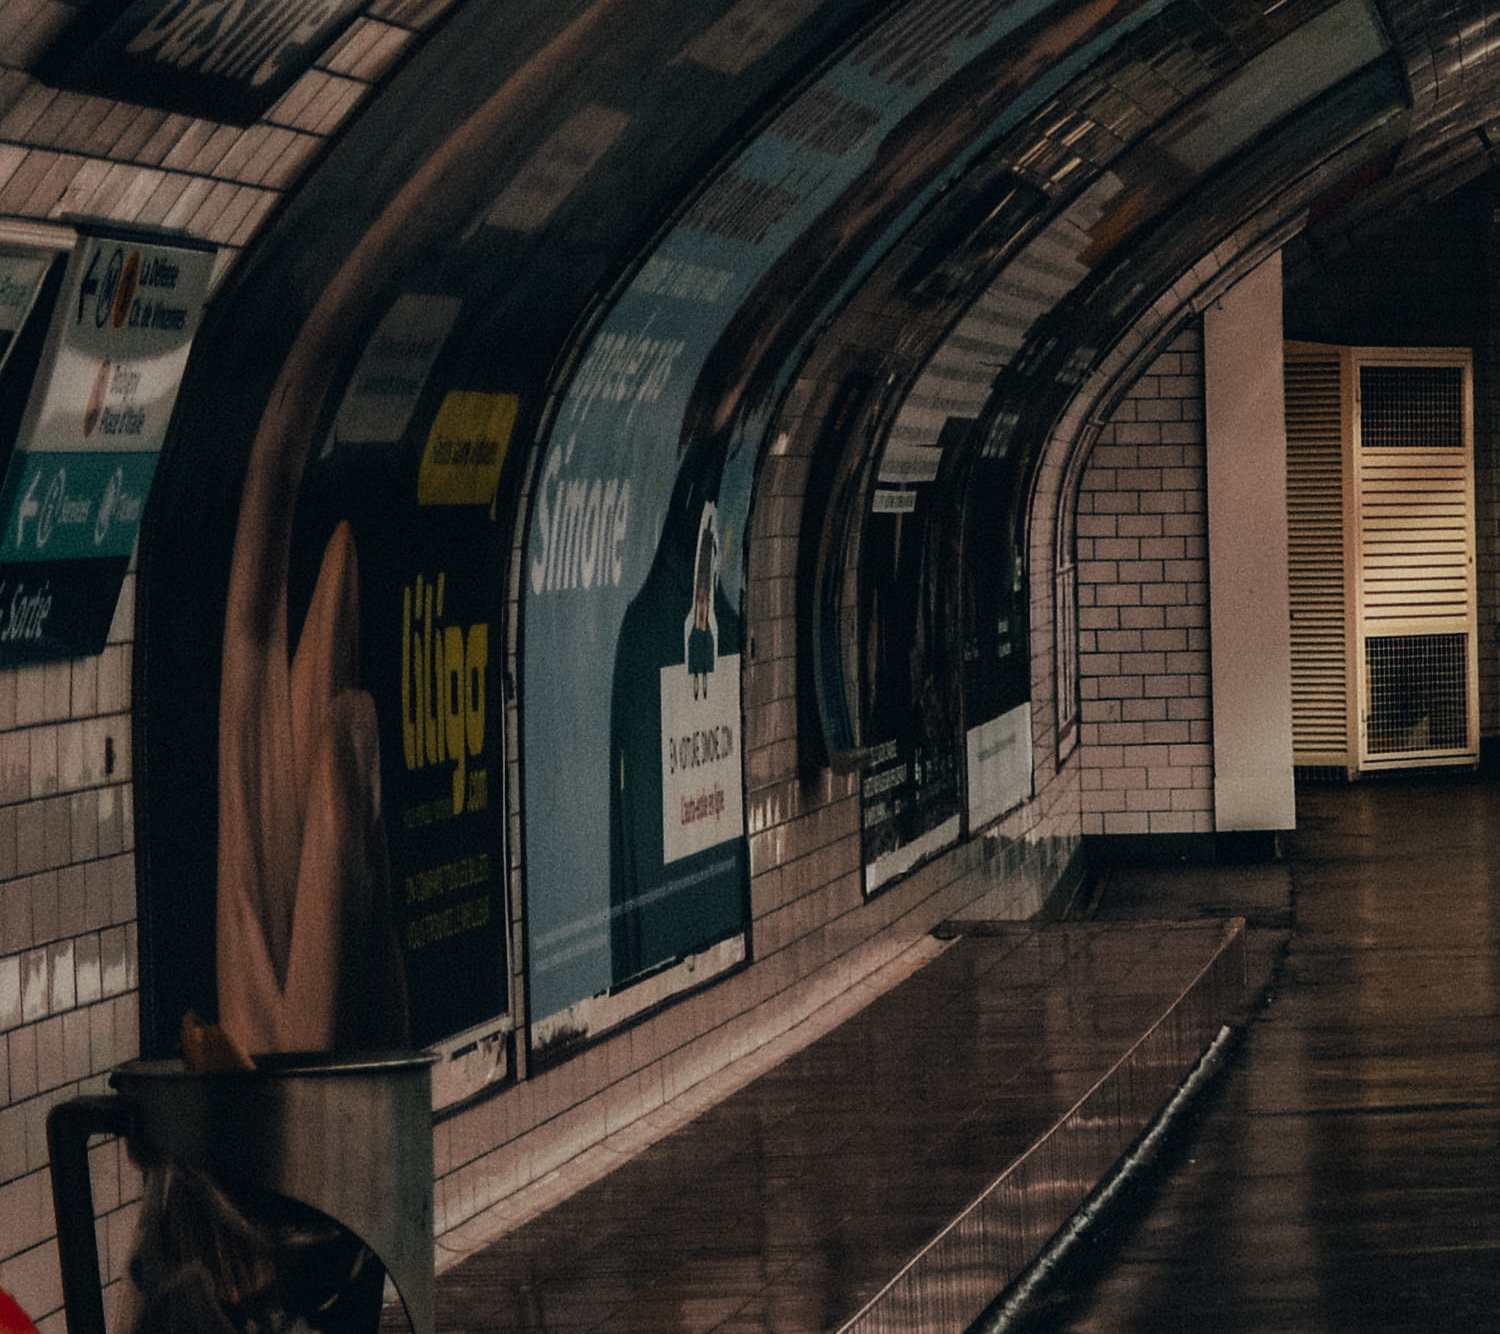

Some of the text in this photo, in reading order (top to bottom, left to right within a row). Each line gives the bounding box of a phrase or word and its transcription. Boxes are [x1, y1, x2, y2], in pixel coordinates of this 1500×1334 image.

[531, 433, 632, 596] Simone
[1, 579, 52, 643] Sortie
[402, 572, 489, 815] liligo
